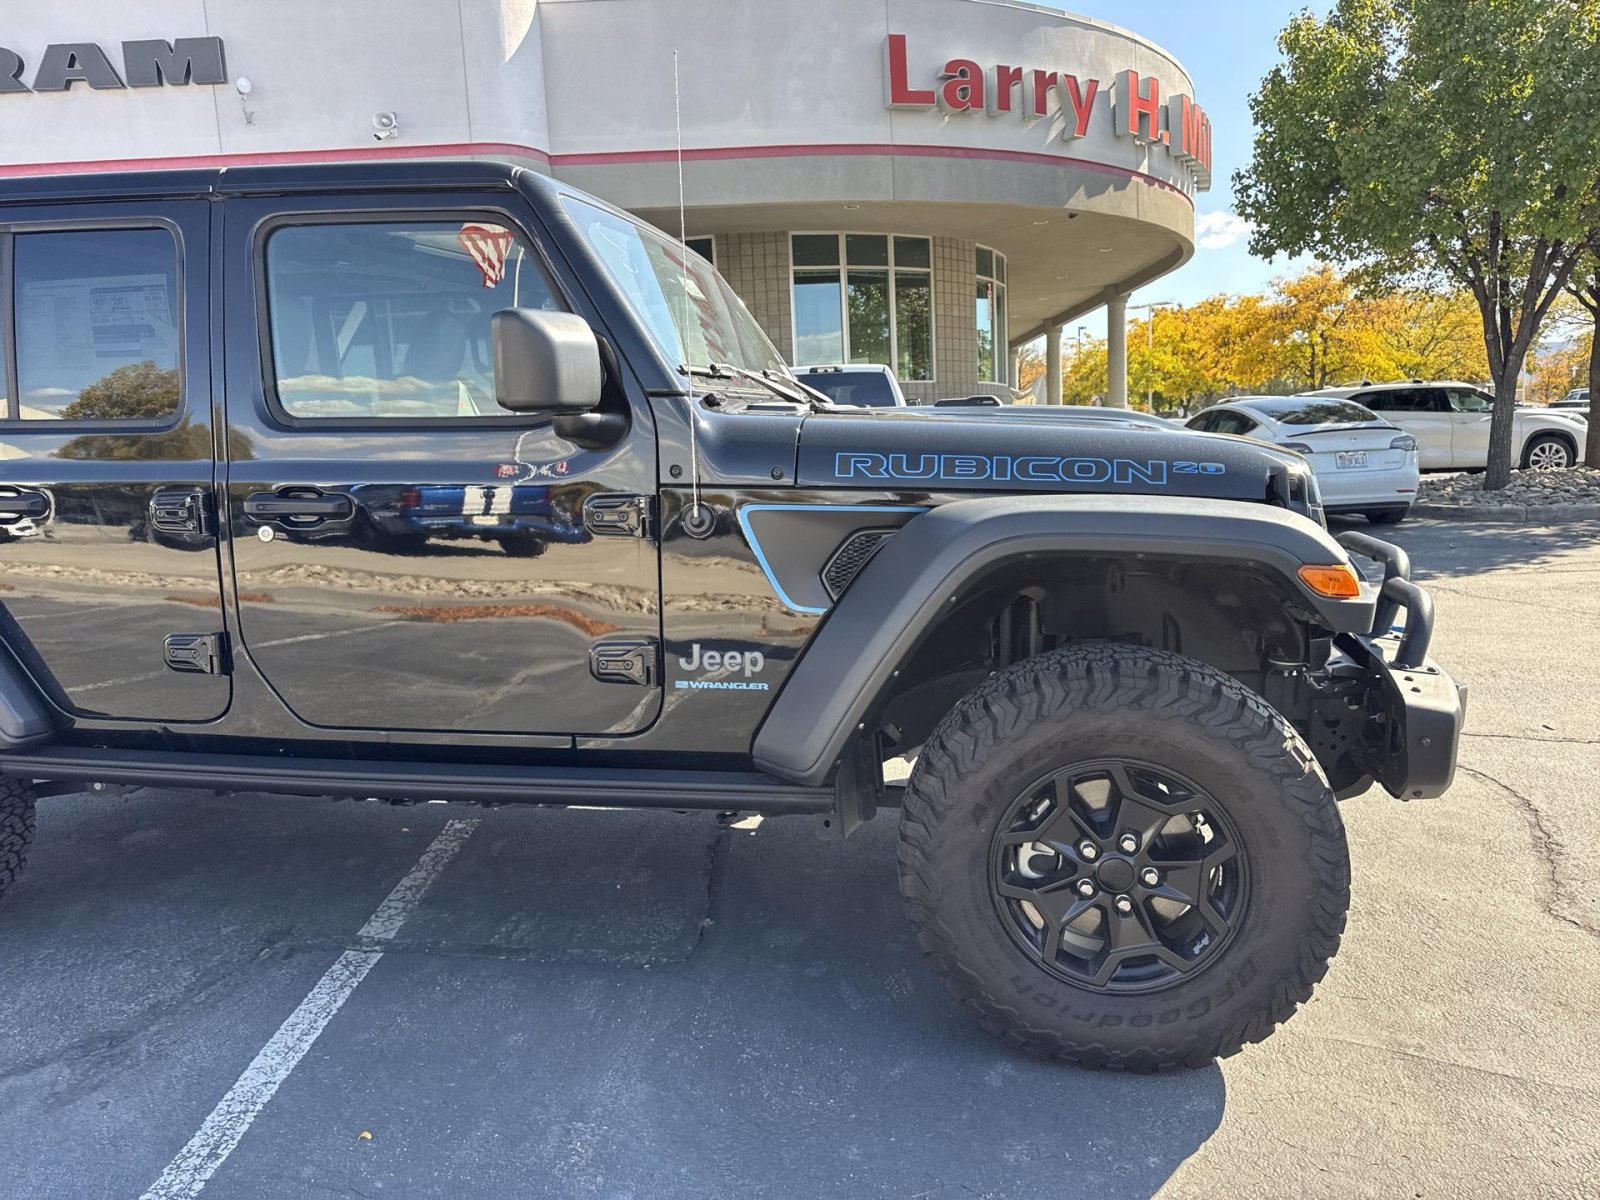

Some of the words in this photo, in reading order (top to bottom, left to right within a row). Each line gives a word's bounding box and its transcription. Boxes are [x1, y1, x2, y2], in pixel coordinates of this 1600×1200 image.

[885, 33, 1100, 141] Larry
[1115, 69, 1171, 147] H.
[834, 452, 1168, 485] RUBICON
[679, 643, 765, 678] Jeep
[689, 681, 769, 691] WRANGLER
